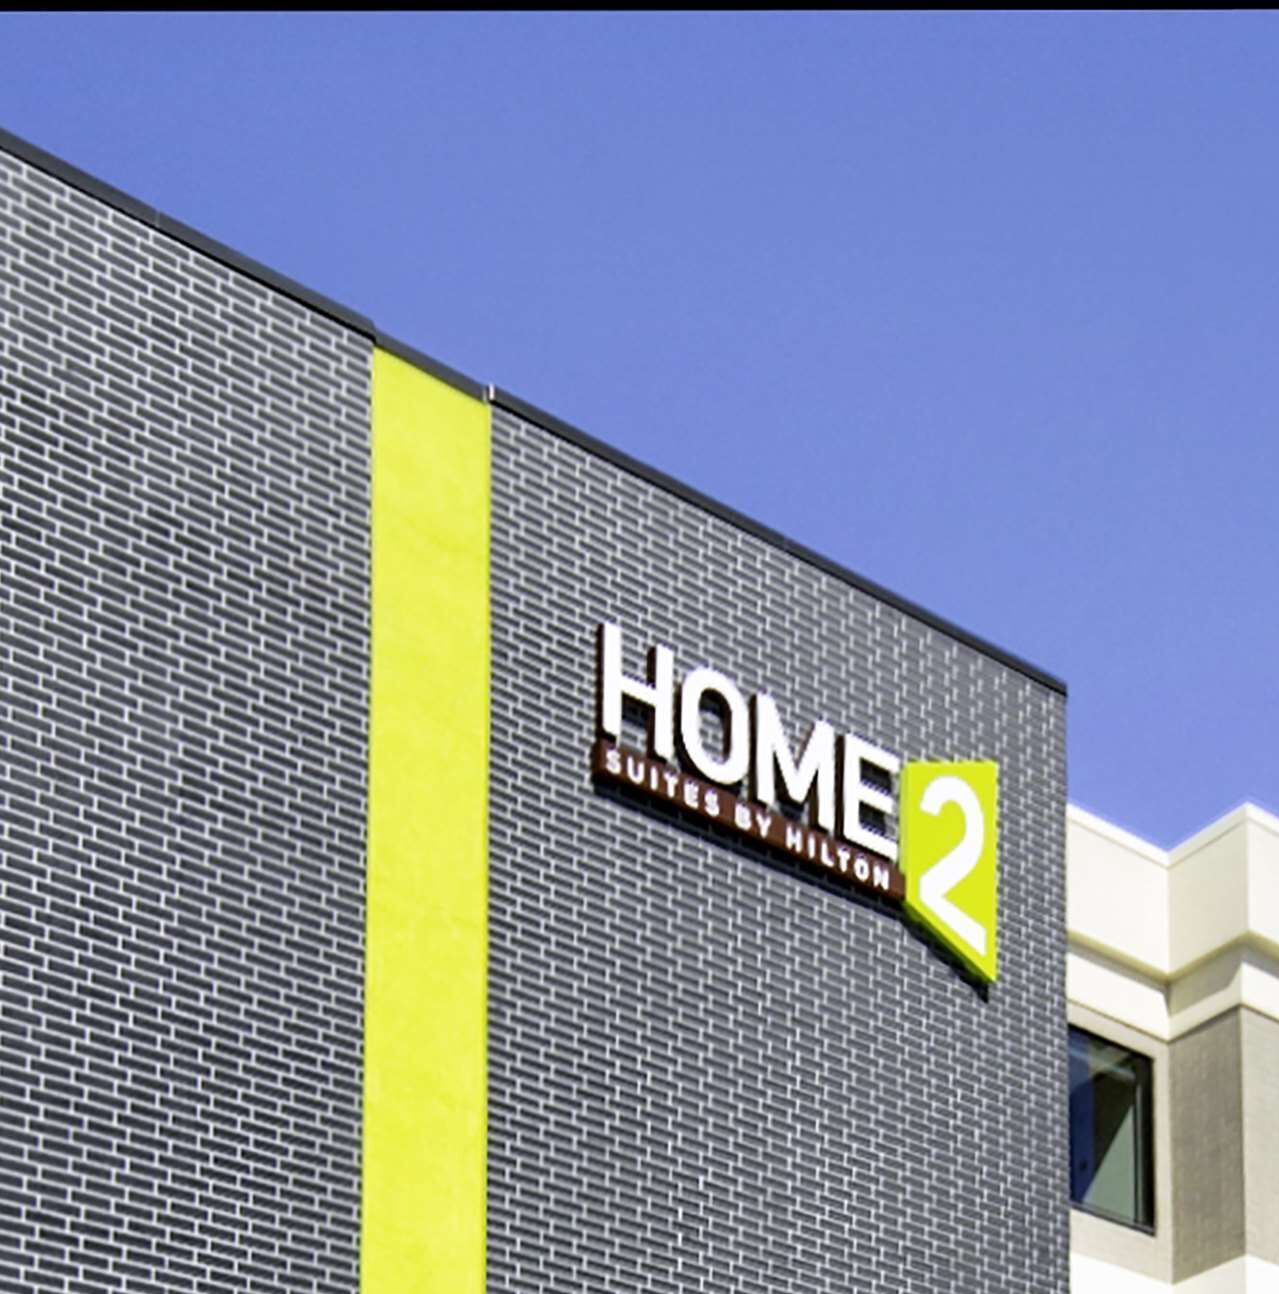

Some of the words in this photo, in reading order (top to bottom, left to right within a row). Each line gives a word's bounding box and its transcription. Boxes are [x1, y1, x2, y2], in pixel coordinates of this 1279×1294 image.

[599, 620, 901, 866] HOME
[919, 775, 988, 958] 2
[605, 747, 720, 818] SUITES
[734, 801, 773, 839] BY
[785, 822, 890, 891] HILTON
